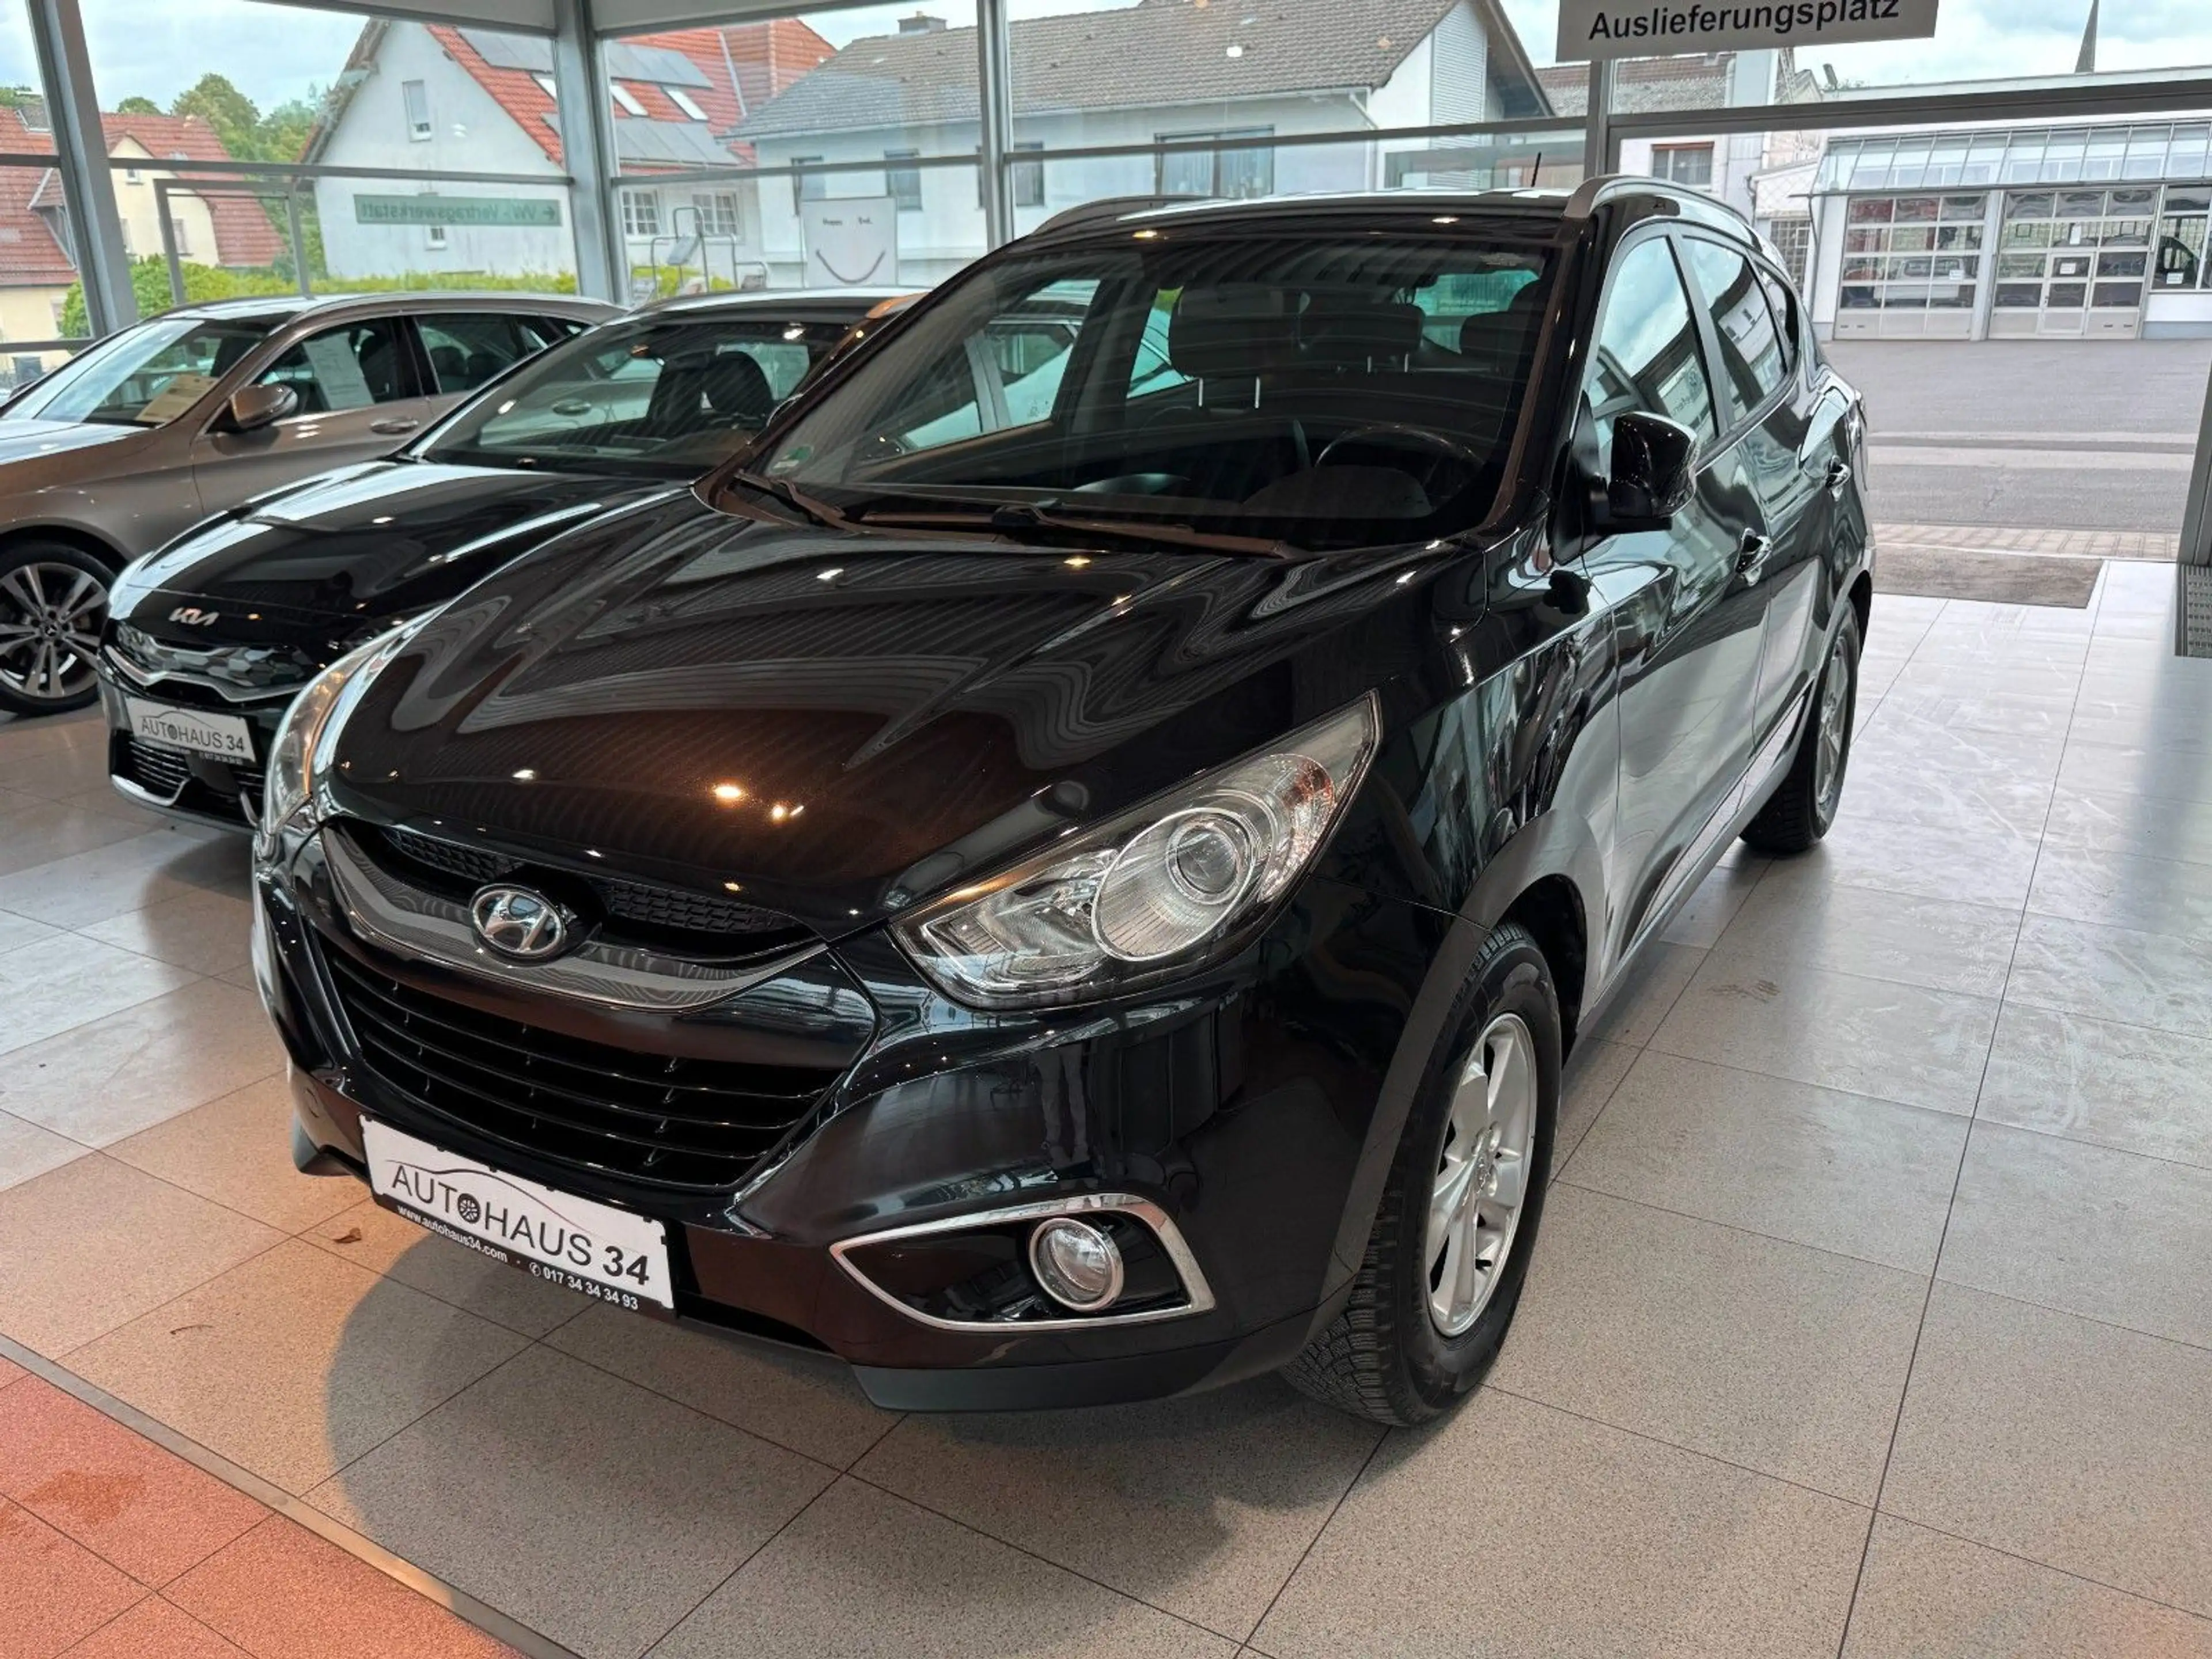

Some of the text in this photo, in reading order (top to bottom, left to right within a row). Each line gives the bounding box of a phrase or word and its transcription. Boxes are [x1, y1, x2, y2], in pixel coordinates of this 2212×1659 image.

[1589, 0, 1900, 40] Auslieferungsplatz
[142, 718, 222, 749] AUTOHAUS
[226, 734, 245, 752] 34
[392, 1164, 650, 1286] AUTOHAUS 34
[396, 1205, 509, 1263] www.autohaus34.com
[543, 1267, 638, 1310] 017 34 34 34 93
